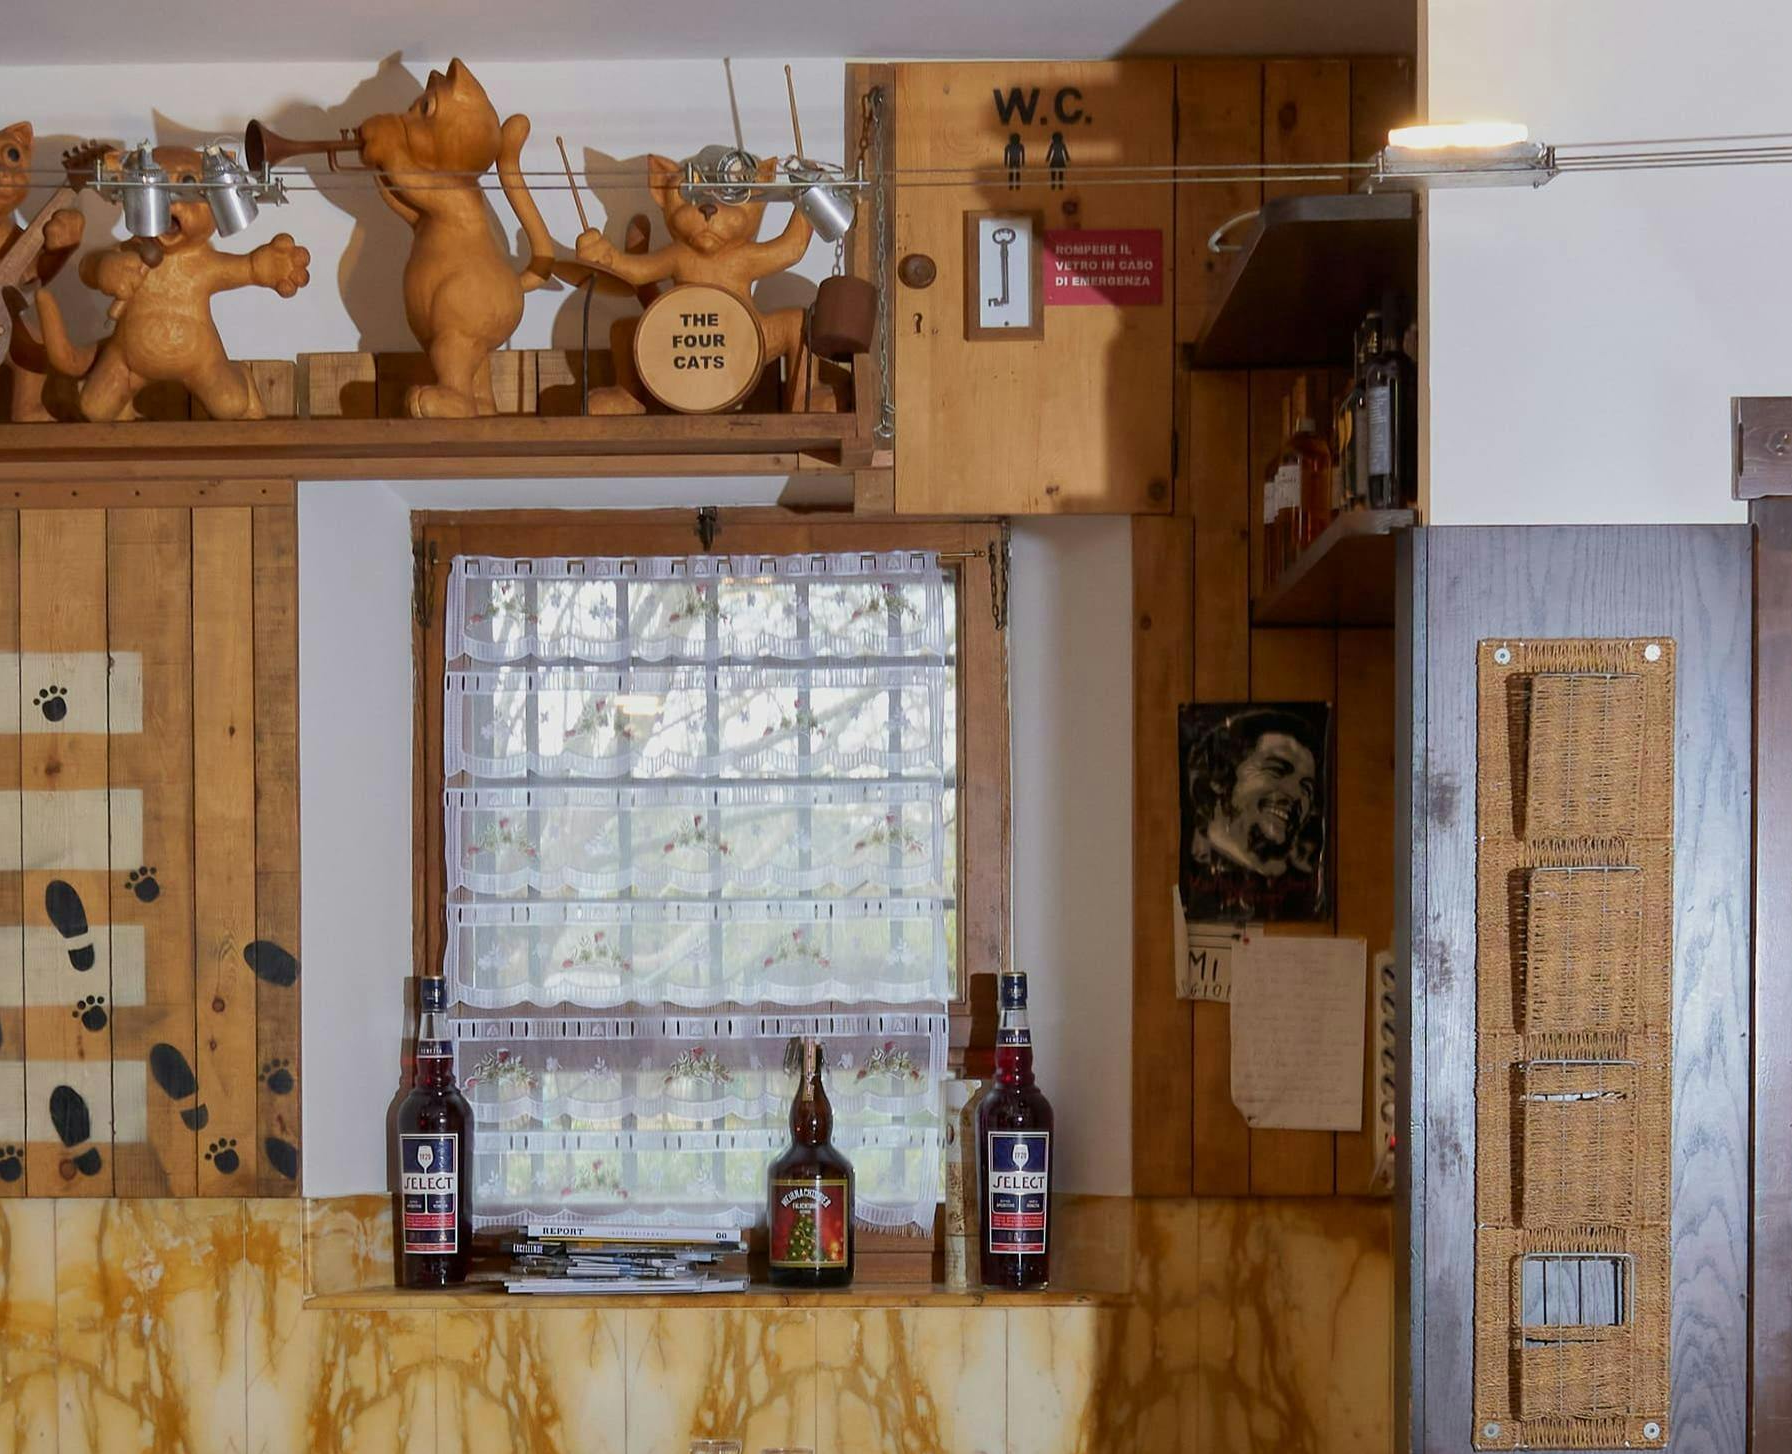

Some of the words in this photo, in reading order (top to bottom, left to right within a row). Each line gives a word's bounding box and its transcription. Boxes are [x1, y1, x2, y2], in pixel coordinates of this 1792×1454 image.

[993, 87, 1093, 126] W.C.
[1055, 244, 1116, 255] ROMPERE
[1120, 244, 1132, 255] IL
[1055, 261, 1098, 271] VETRO
[1101, 261, 1115, 270] IN
[1118, 261, 1154, 270] CASO
[1055, 277, 1068, 286] DI
[1071, 276, 1150, 287] EMERGENZA
[680, 313, 719, 327] THE
[672, 334, 726, 348] FOUR
[673, 355, 725, 369] CATS
[404, 1177, 454, 1190] SELECT
[993, 1175, 1045, 1189] SELECT
[542, 1227, 585, 1236] REPORT
